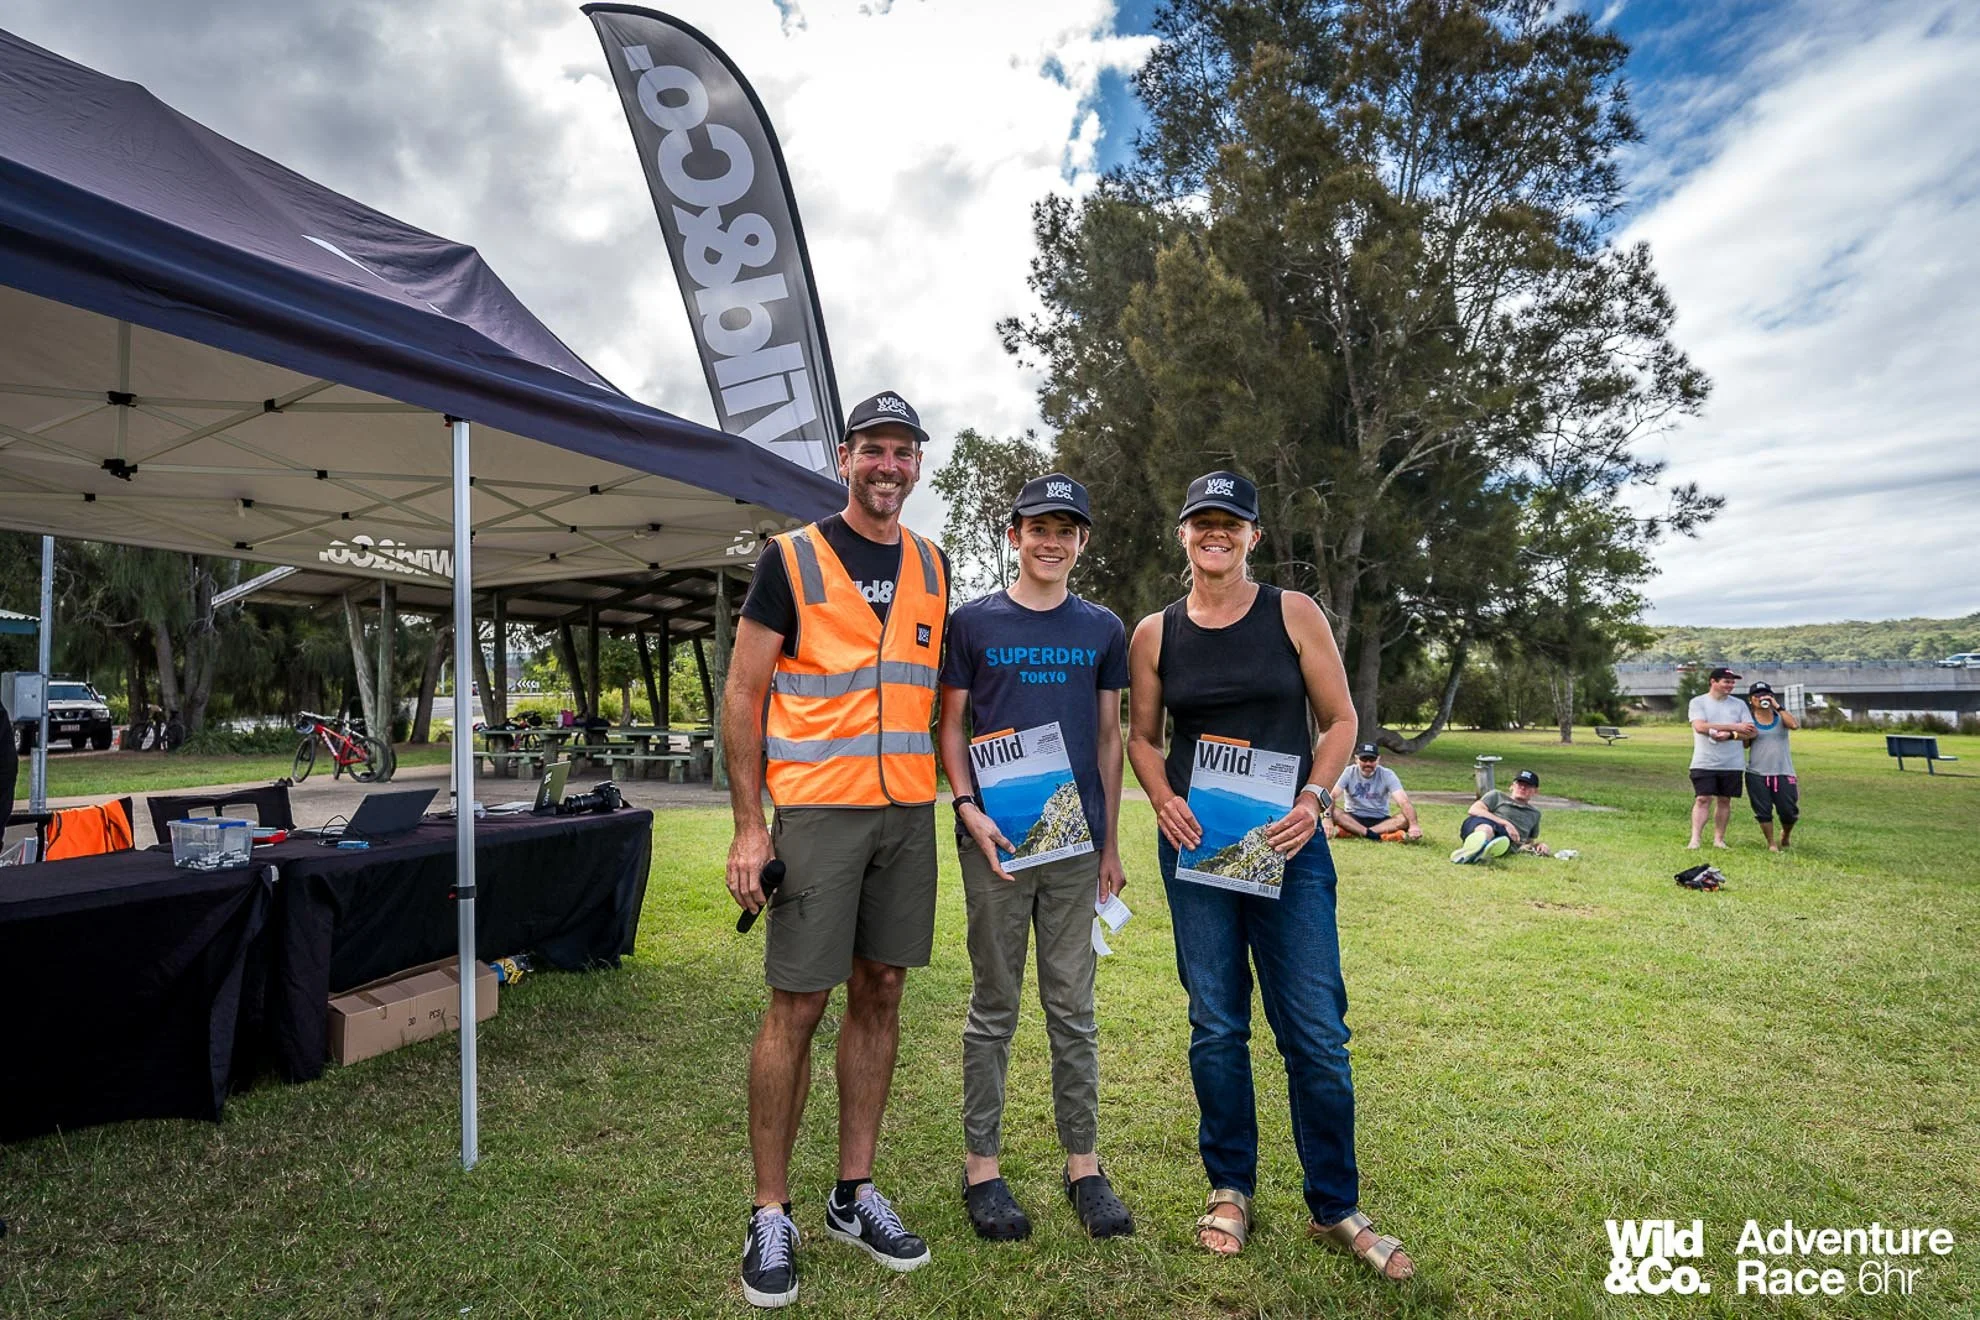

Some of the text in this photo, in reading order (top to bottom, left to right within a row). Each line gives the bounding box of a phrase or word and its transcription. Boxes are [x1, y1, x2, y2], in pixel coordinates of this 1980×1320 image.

[876, 396, 906, 410] Wild
[1046, 481, 1072, 493] Wild
[1207, 478, 1235, 490] Wild
[1046, 490, 1074, 501] &Co.
[1205, 486, 1234, 497] &Co.
[985, 646, 1097, 666] SUPERDRY
[1019, 671, 1067, 684] TOKYO
[972, 735, 1024, 769] Wild
[1199, 742, 1253, 776] Wild
